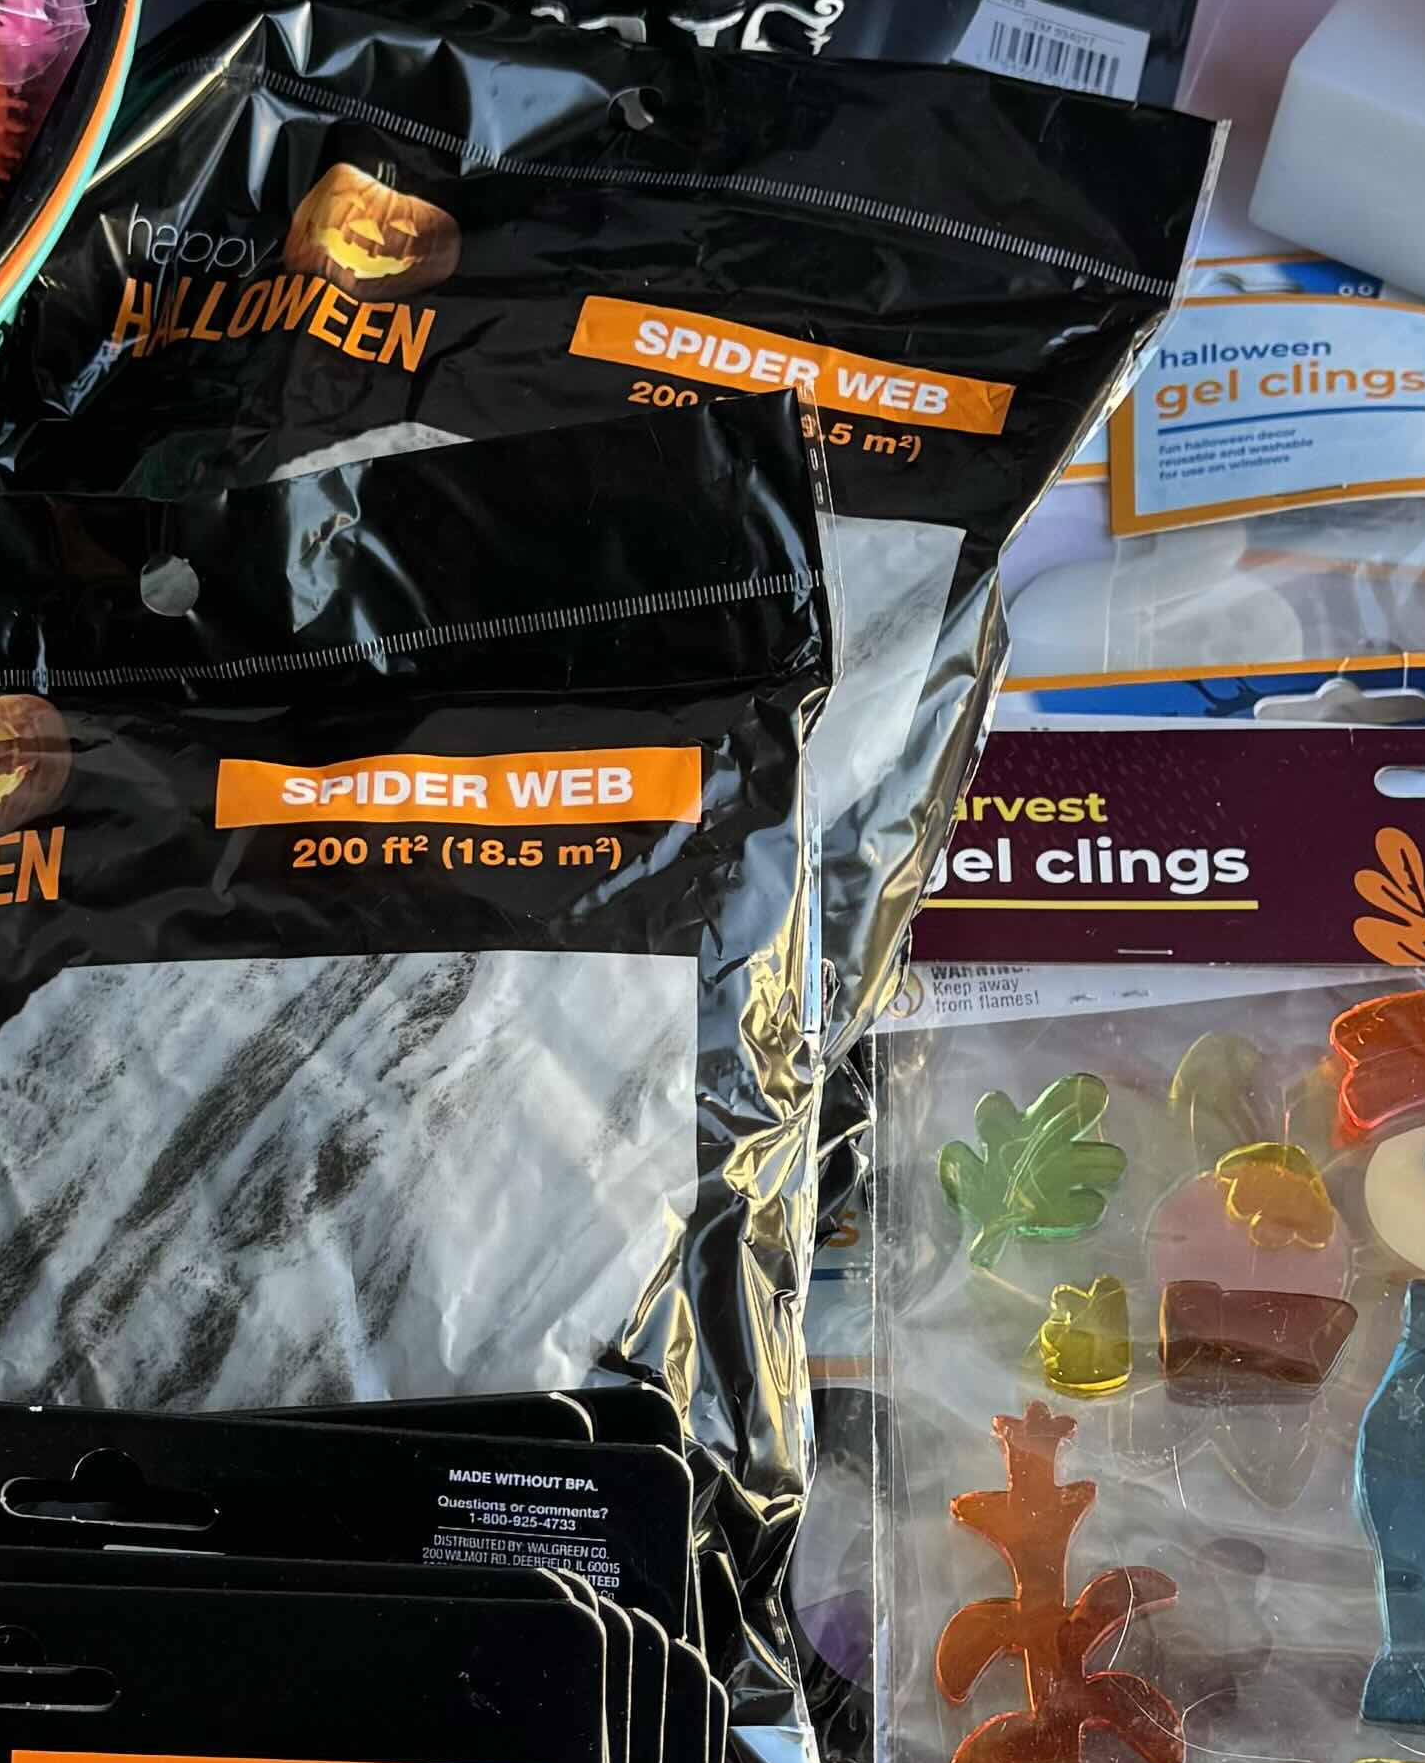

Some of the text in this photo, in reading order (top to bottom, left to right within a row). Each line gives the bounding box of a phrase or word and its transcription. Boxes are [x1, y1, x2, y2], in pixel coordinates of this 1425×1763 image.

[127, 202, 277, 277] happy
[112, 274, 436, 373] HALLOWEEN
[634, 320, 950, 416] SPIDER WEB
[1160, 339, 1332, 370] halloween
[1155, 369, 1239, 420] gel
[281, 766, 635, 810] SPIDER WEB
[953, 793, 1109, 824] arvest
[292, 837, 368, 869] 200
[442, 836, 544, 870] (18.5
[1035, 836, 1250, 895] clings
[932, 978, 1020, 997] Keep away
[935, 997, 973, 1013] from
[448, 1469, 599, 1492] MADE WITHOUT BPA.
[437, 1495, 609, 1520] Questions or comments?
[469, 1512, 576, 1531] 1-800-925-4733
[422, 1547, 444, 1560] 200
[444, 1549, 488, 1564] WILMOT
[575, 1560, 586, 1572] IL
[587, 1560, 621, 1574] 60015
[433, 1534, 610, 1560] DISTRIBUTED BY: WALGREEN CO.
